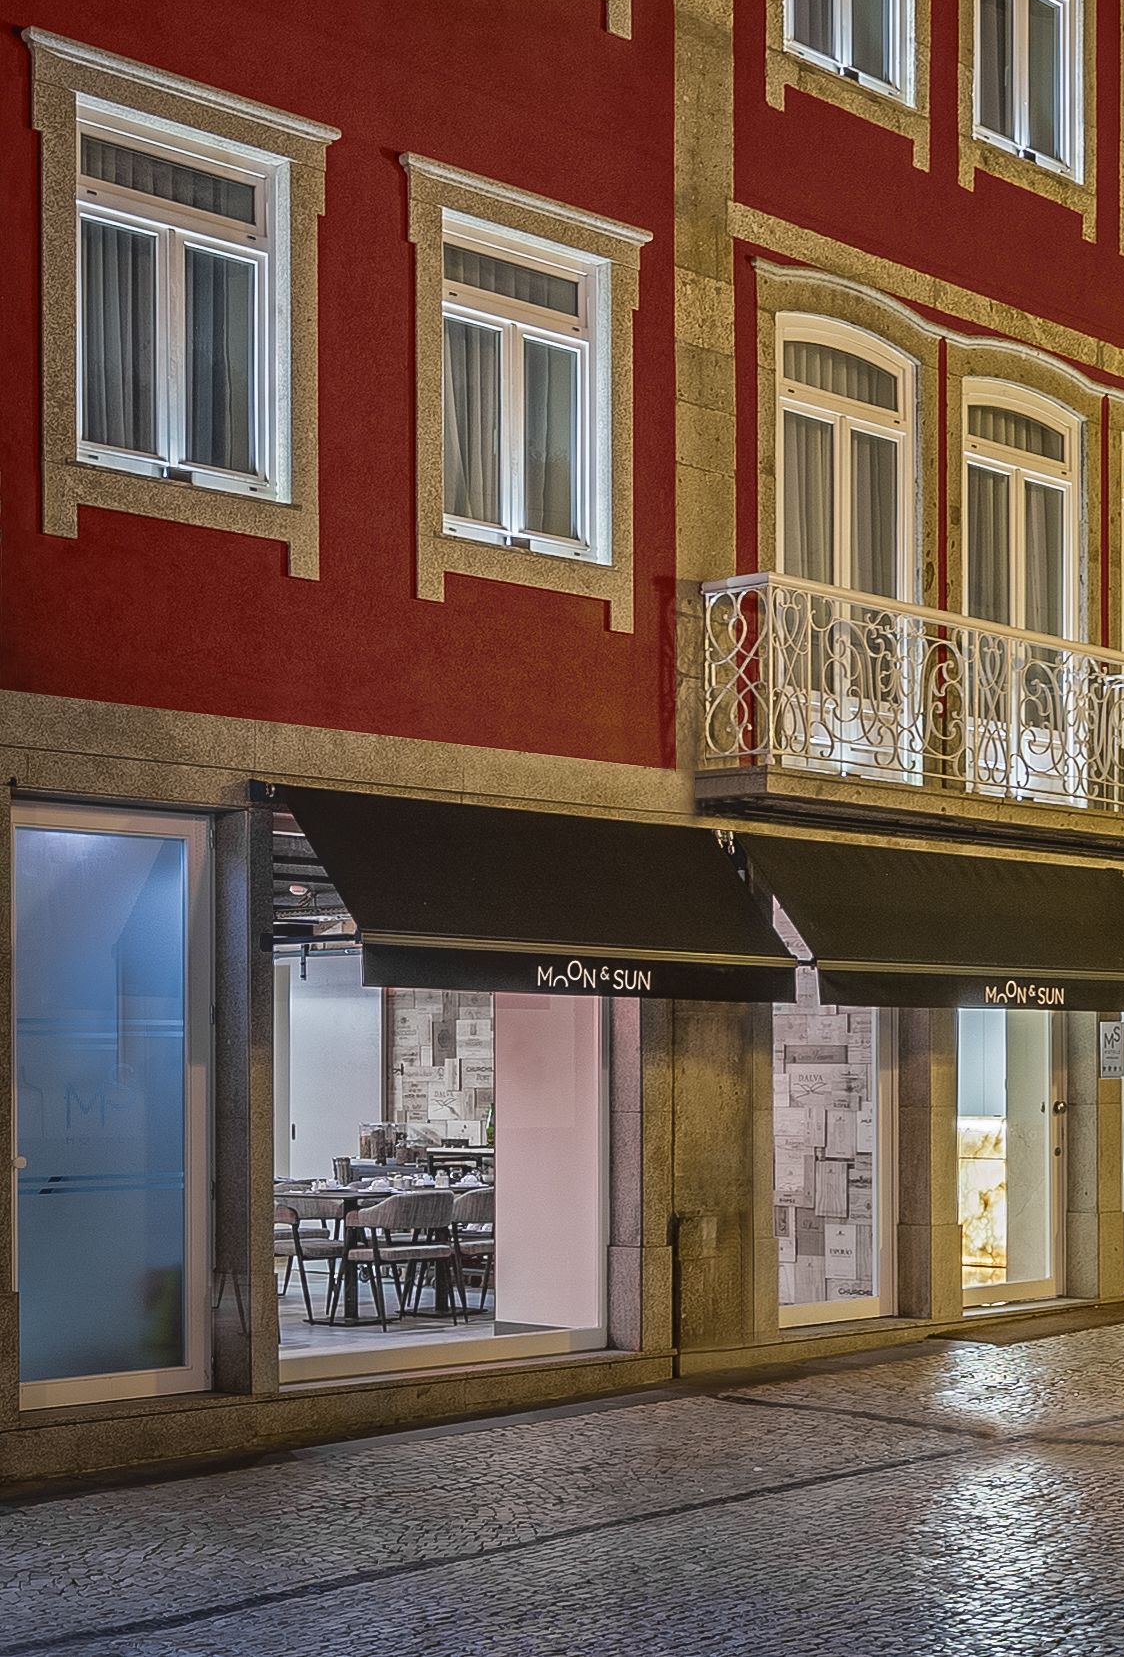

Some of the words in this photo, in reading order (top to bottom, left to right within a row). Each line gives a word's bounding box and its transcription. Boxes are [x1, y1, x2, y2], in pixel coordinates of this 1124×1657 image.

[600, 965, 610, 981] &
[613, 969, 651, 991] SUN
[1028, 984, 1036, 997] &
[1037, 987, 1064, 1005] SUN
[1104, 1026, 1121, 1049] MS
[798, 1074, 823, 1082] DALVA
